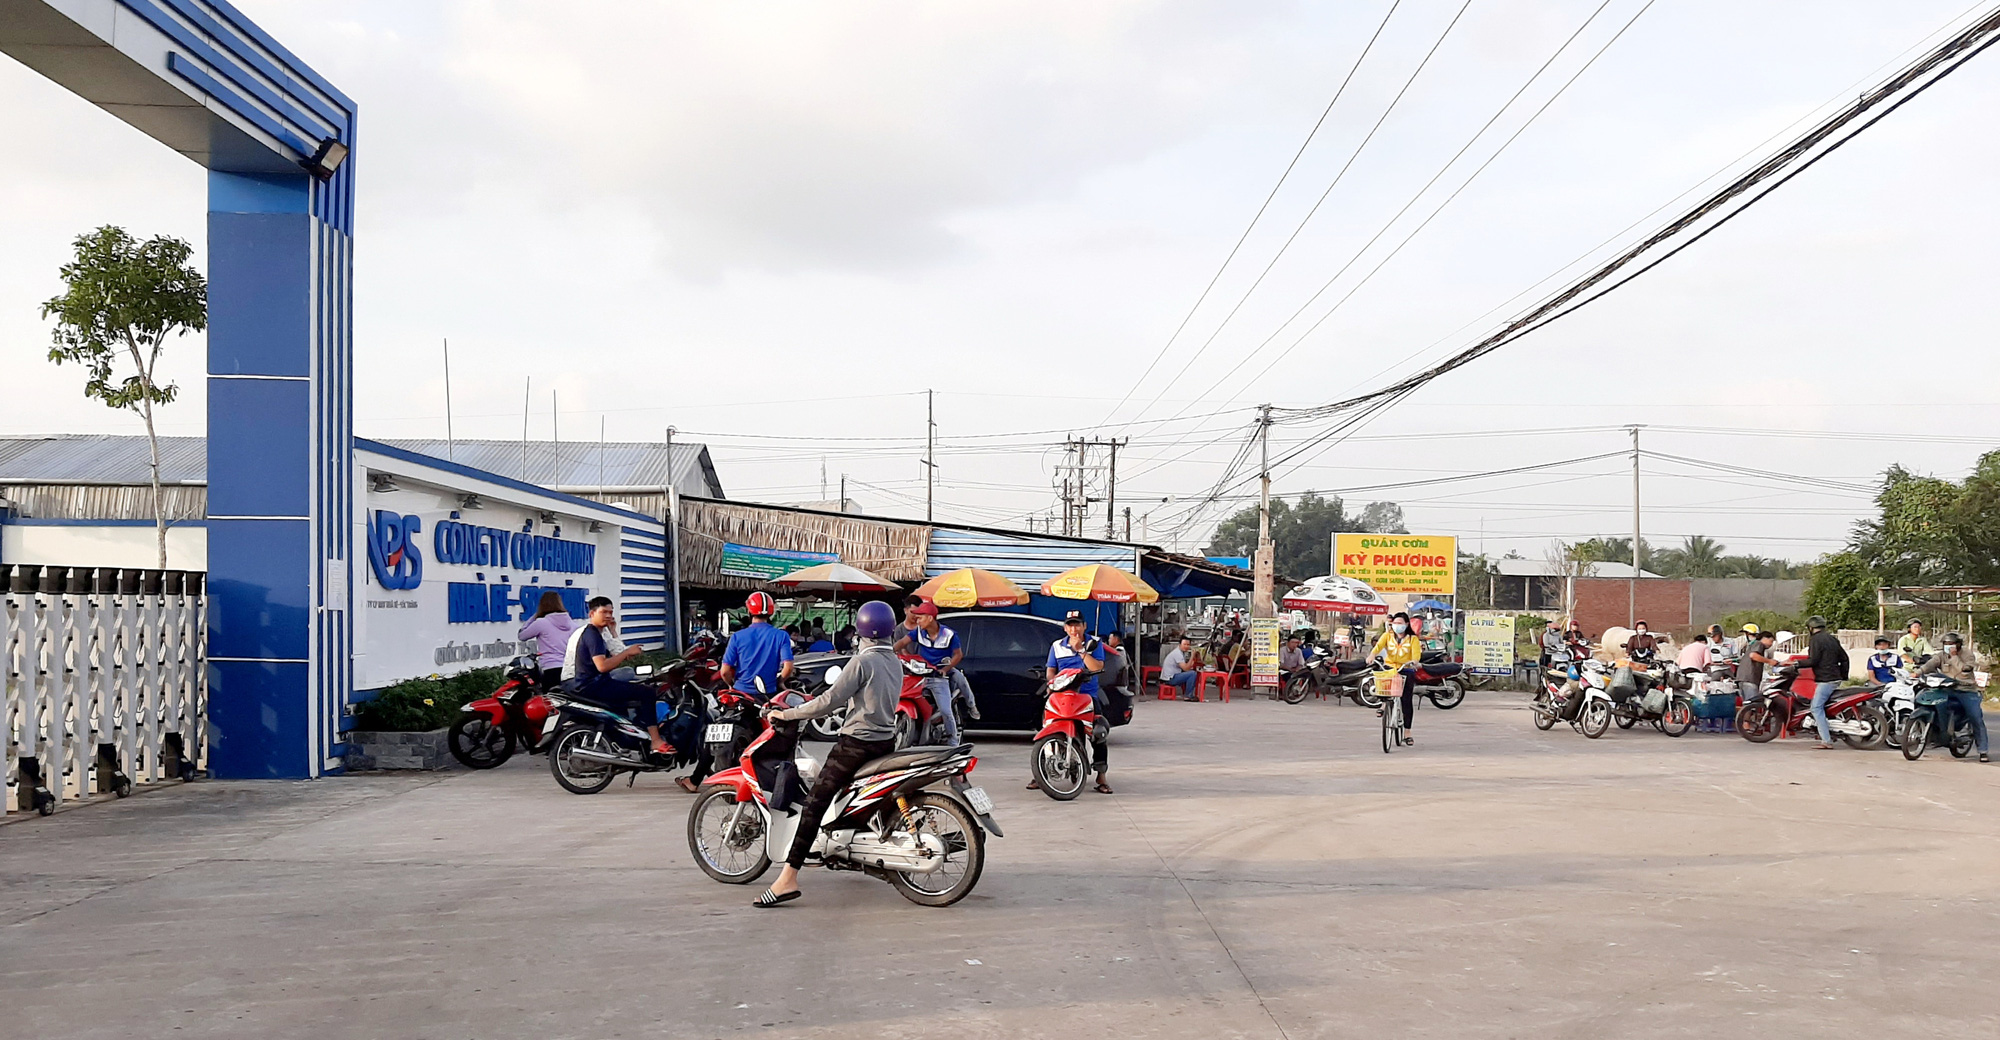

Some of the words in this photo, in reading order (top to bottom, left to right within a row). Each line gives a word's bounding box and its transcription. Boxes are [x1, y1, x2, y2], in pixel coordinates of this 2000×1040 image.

[1361, 537, 1399, 549] QUÁN
[1401, 539, 1429, 548] CƠM
[1343, 551, 1368, 565] KỲ
[1373, 553, 1446, 567] PHƯƠNG
